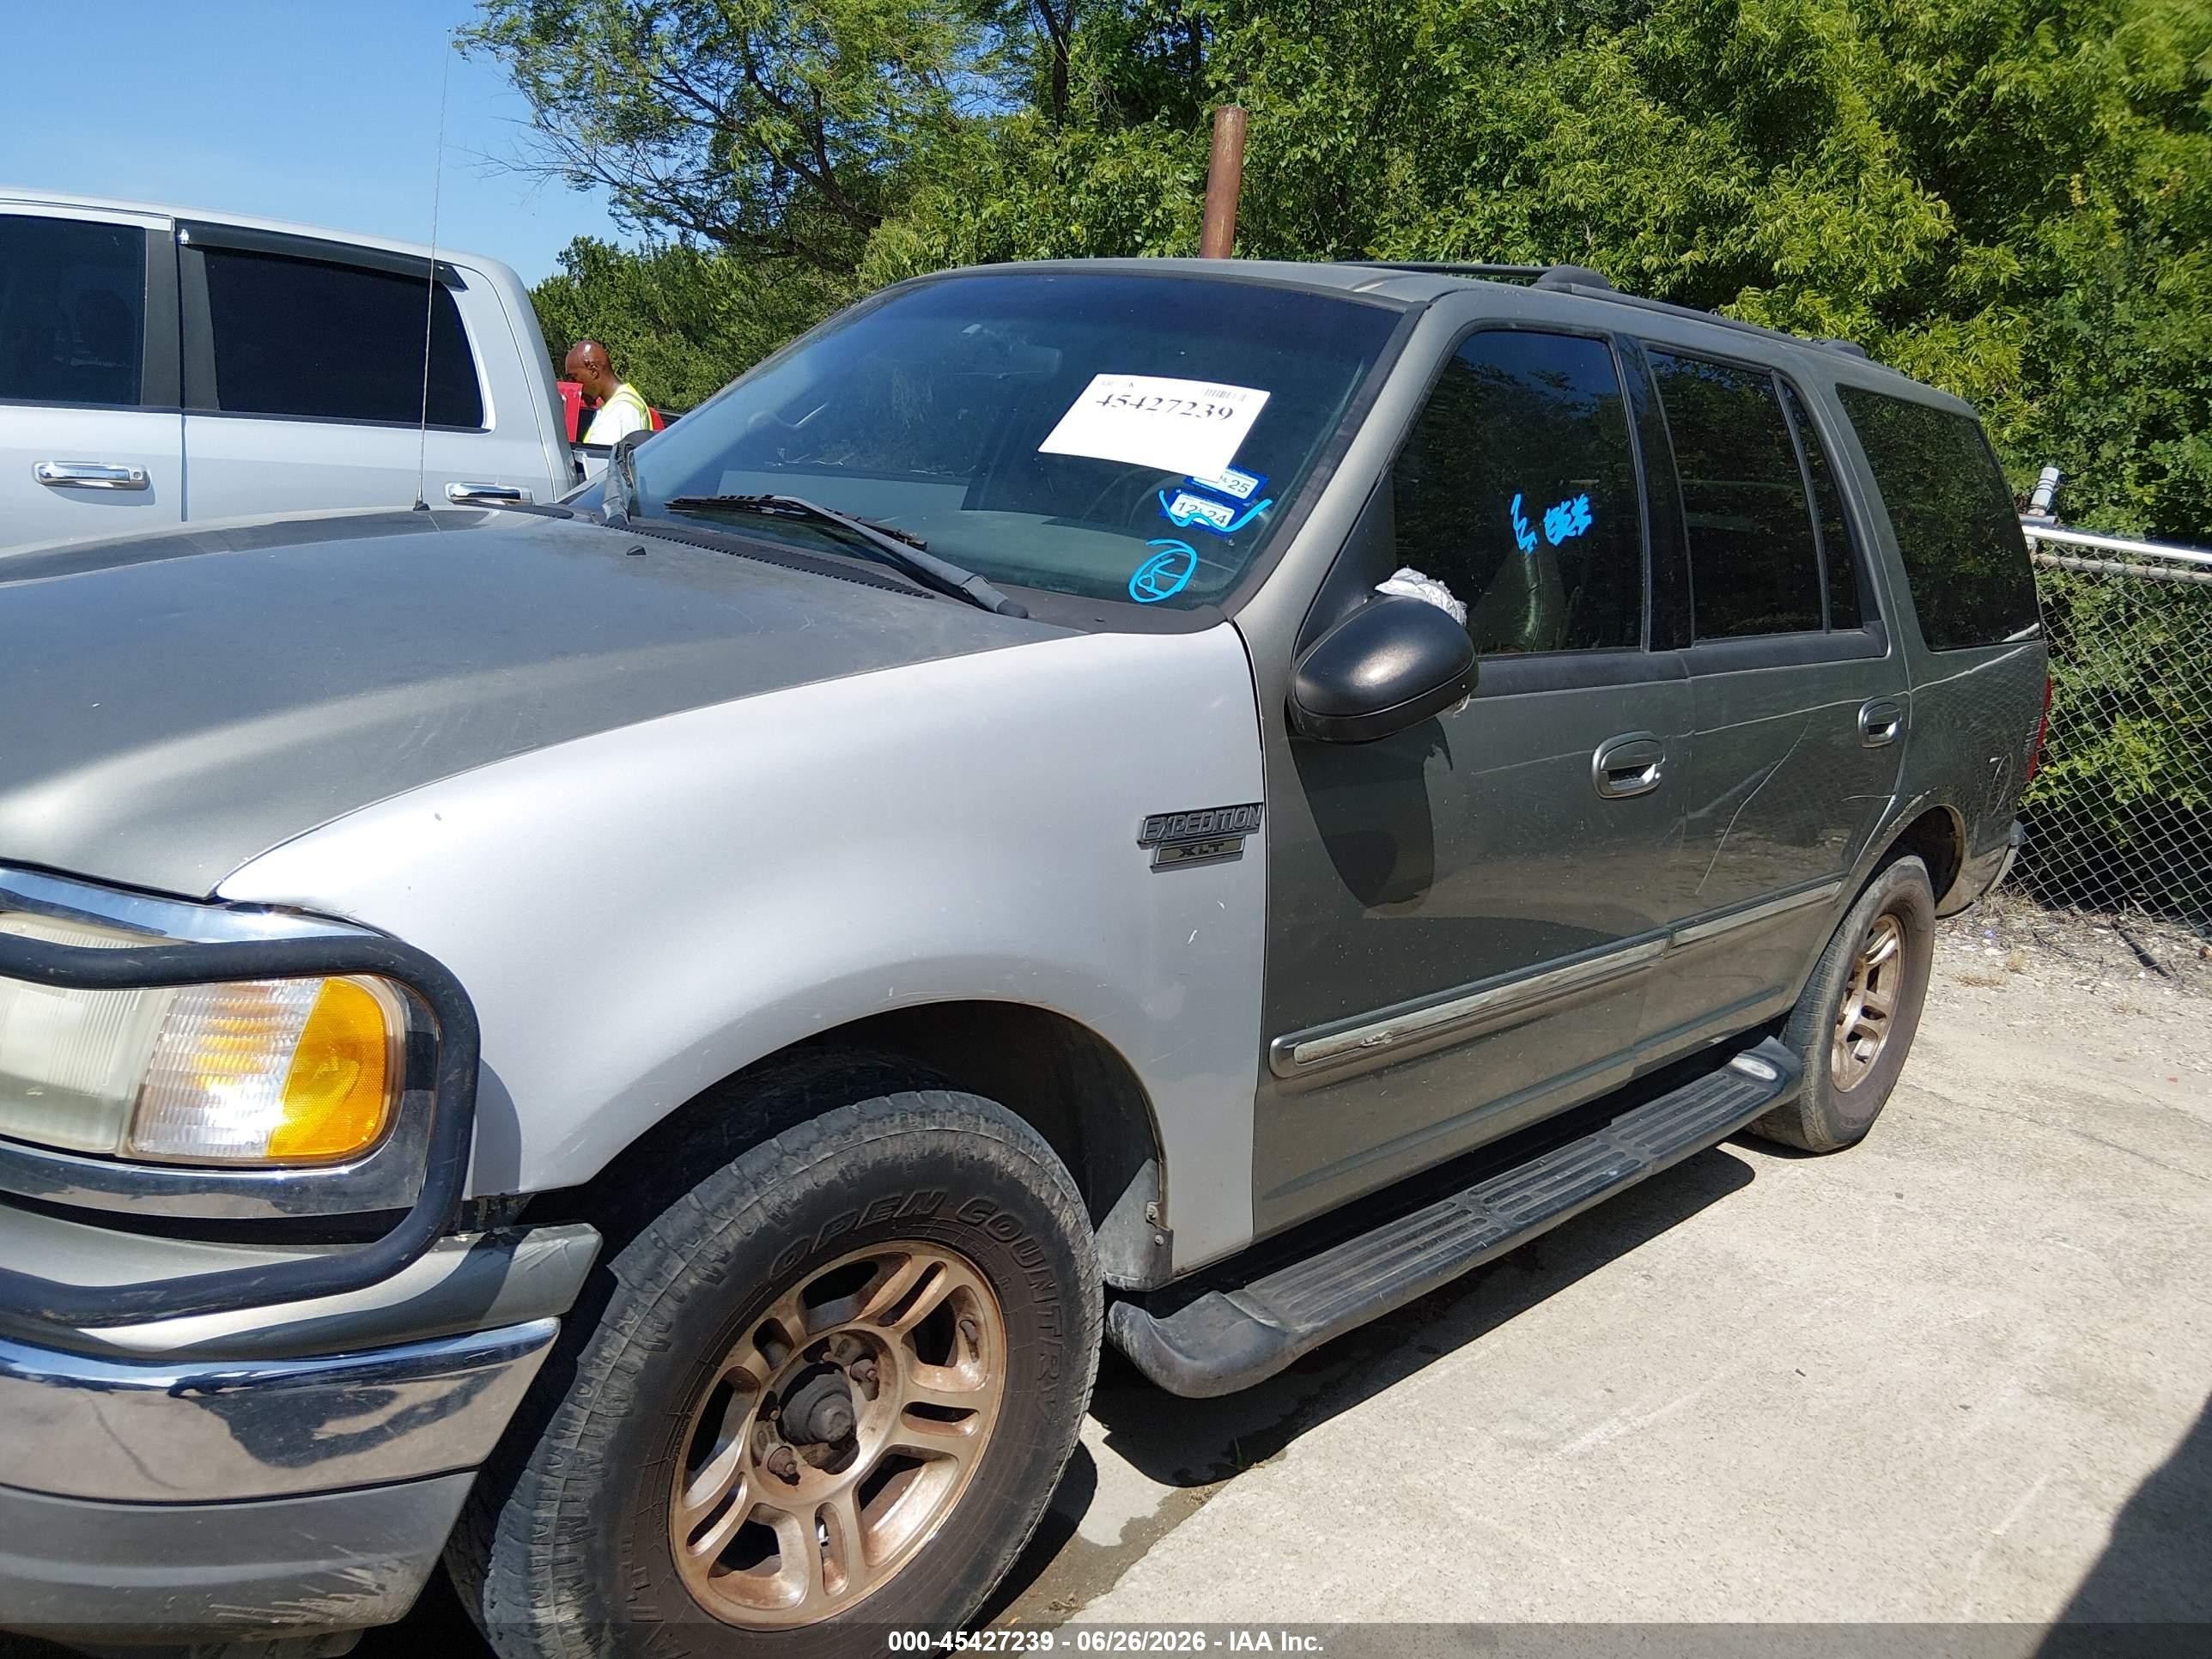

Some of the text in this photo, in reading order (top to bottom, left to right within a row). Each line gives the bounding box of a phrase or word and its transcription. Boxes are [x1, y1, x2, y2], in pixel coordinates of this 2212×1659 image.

[1095, 392, 1234, 420] 45427239
[1227, 479, 1251, 494] 25
[1178, 501, 1228, 525] 12 24
[1142, 803, 1263, 841] EXPEDITION
[1178, 842, 1224, 858] XLT
[769, 1188, 1066, 1408] OPEN COUNTRY
